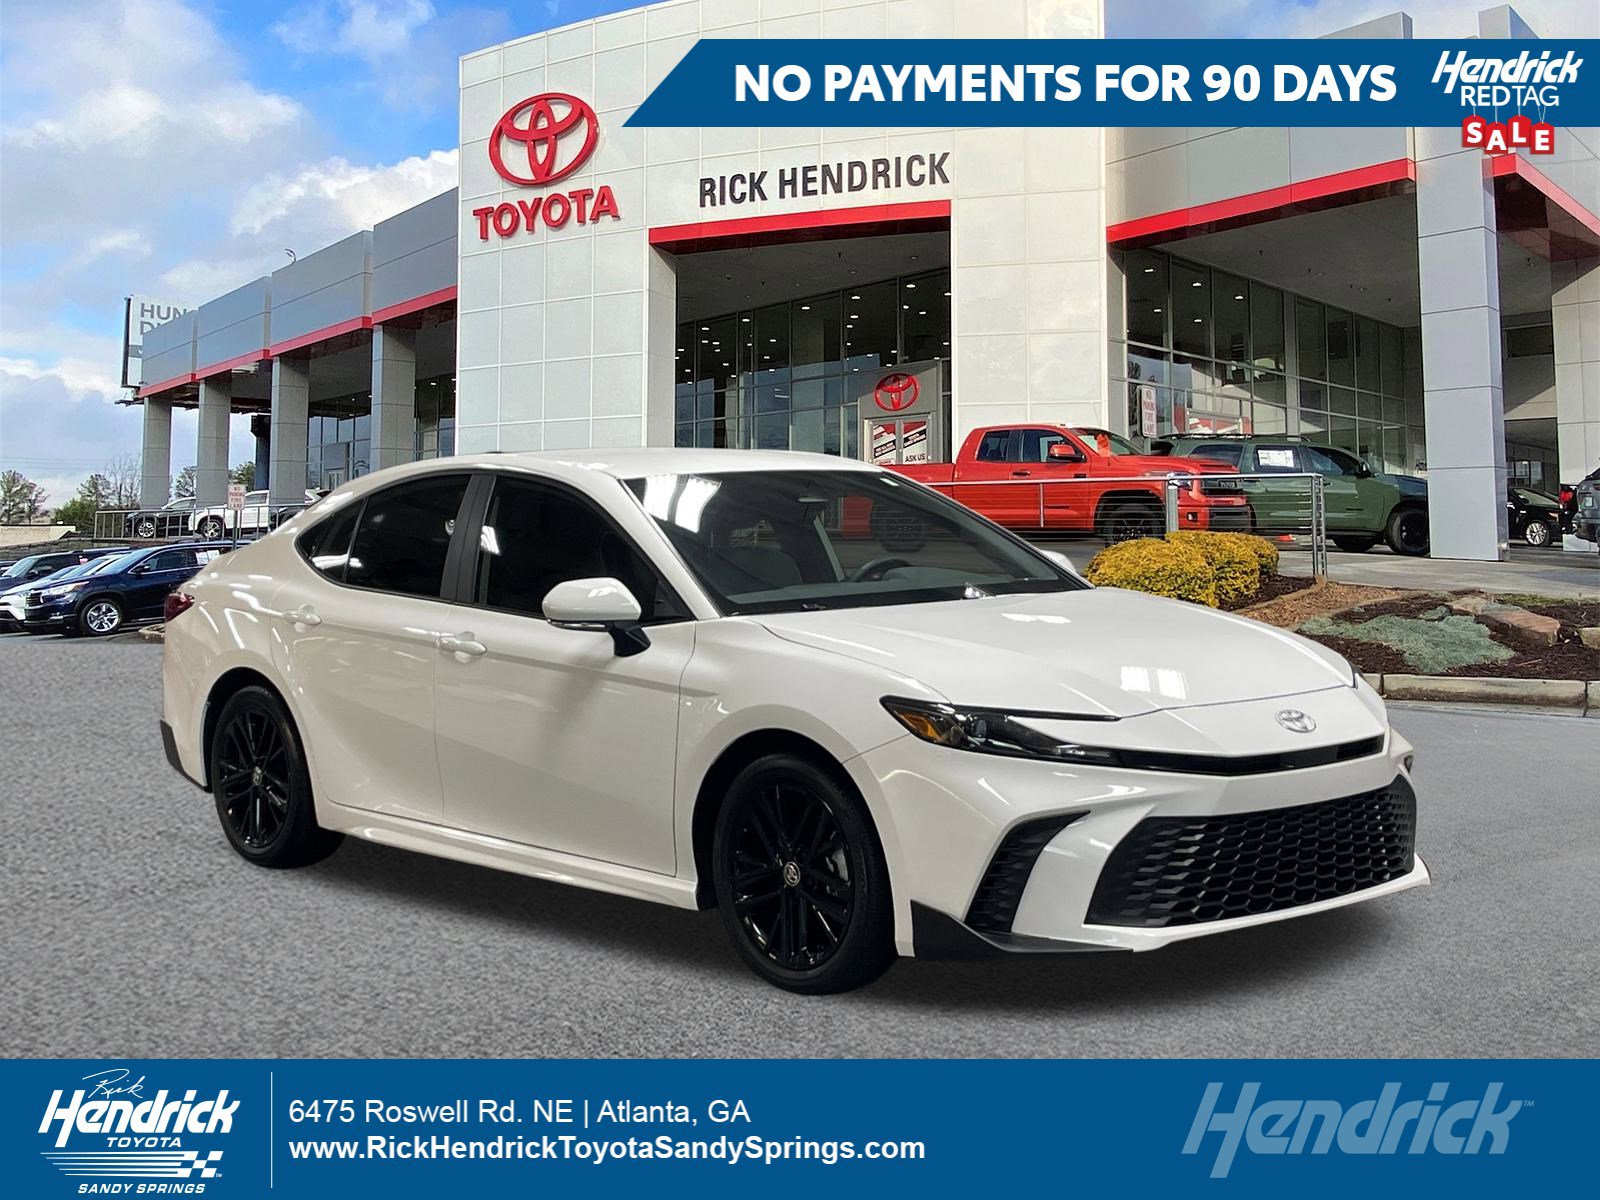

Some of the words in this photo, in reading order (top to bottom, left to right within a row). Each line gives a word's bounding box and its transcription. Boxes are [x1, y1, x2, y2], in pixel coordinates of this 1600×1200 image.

[699, 171, 768, 208] RICK
[778, 152, 951, 200] HENDRICK
[473, 185, 621, 241] TOYOTA
[917, 453, 926, 461] US
